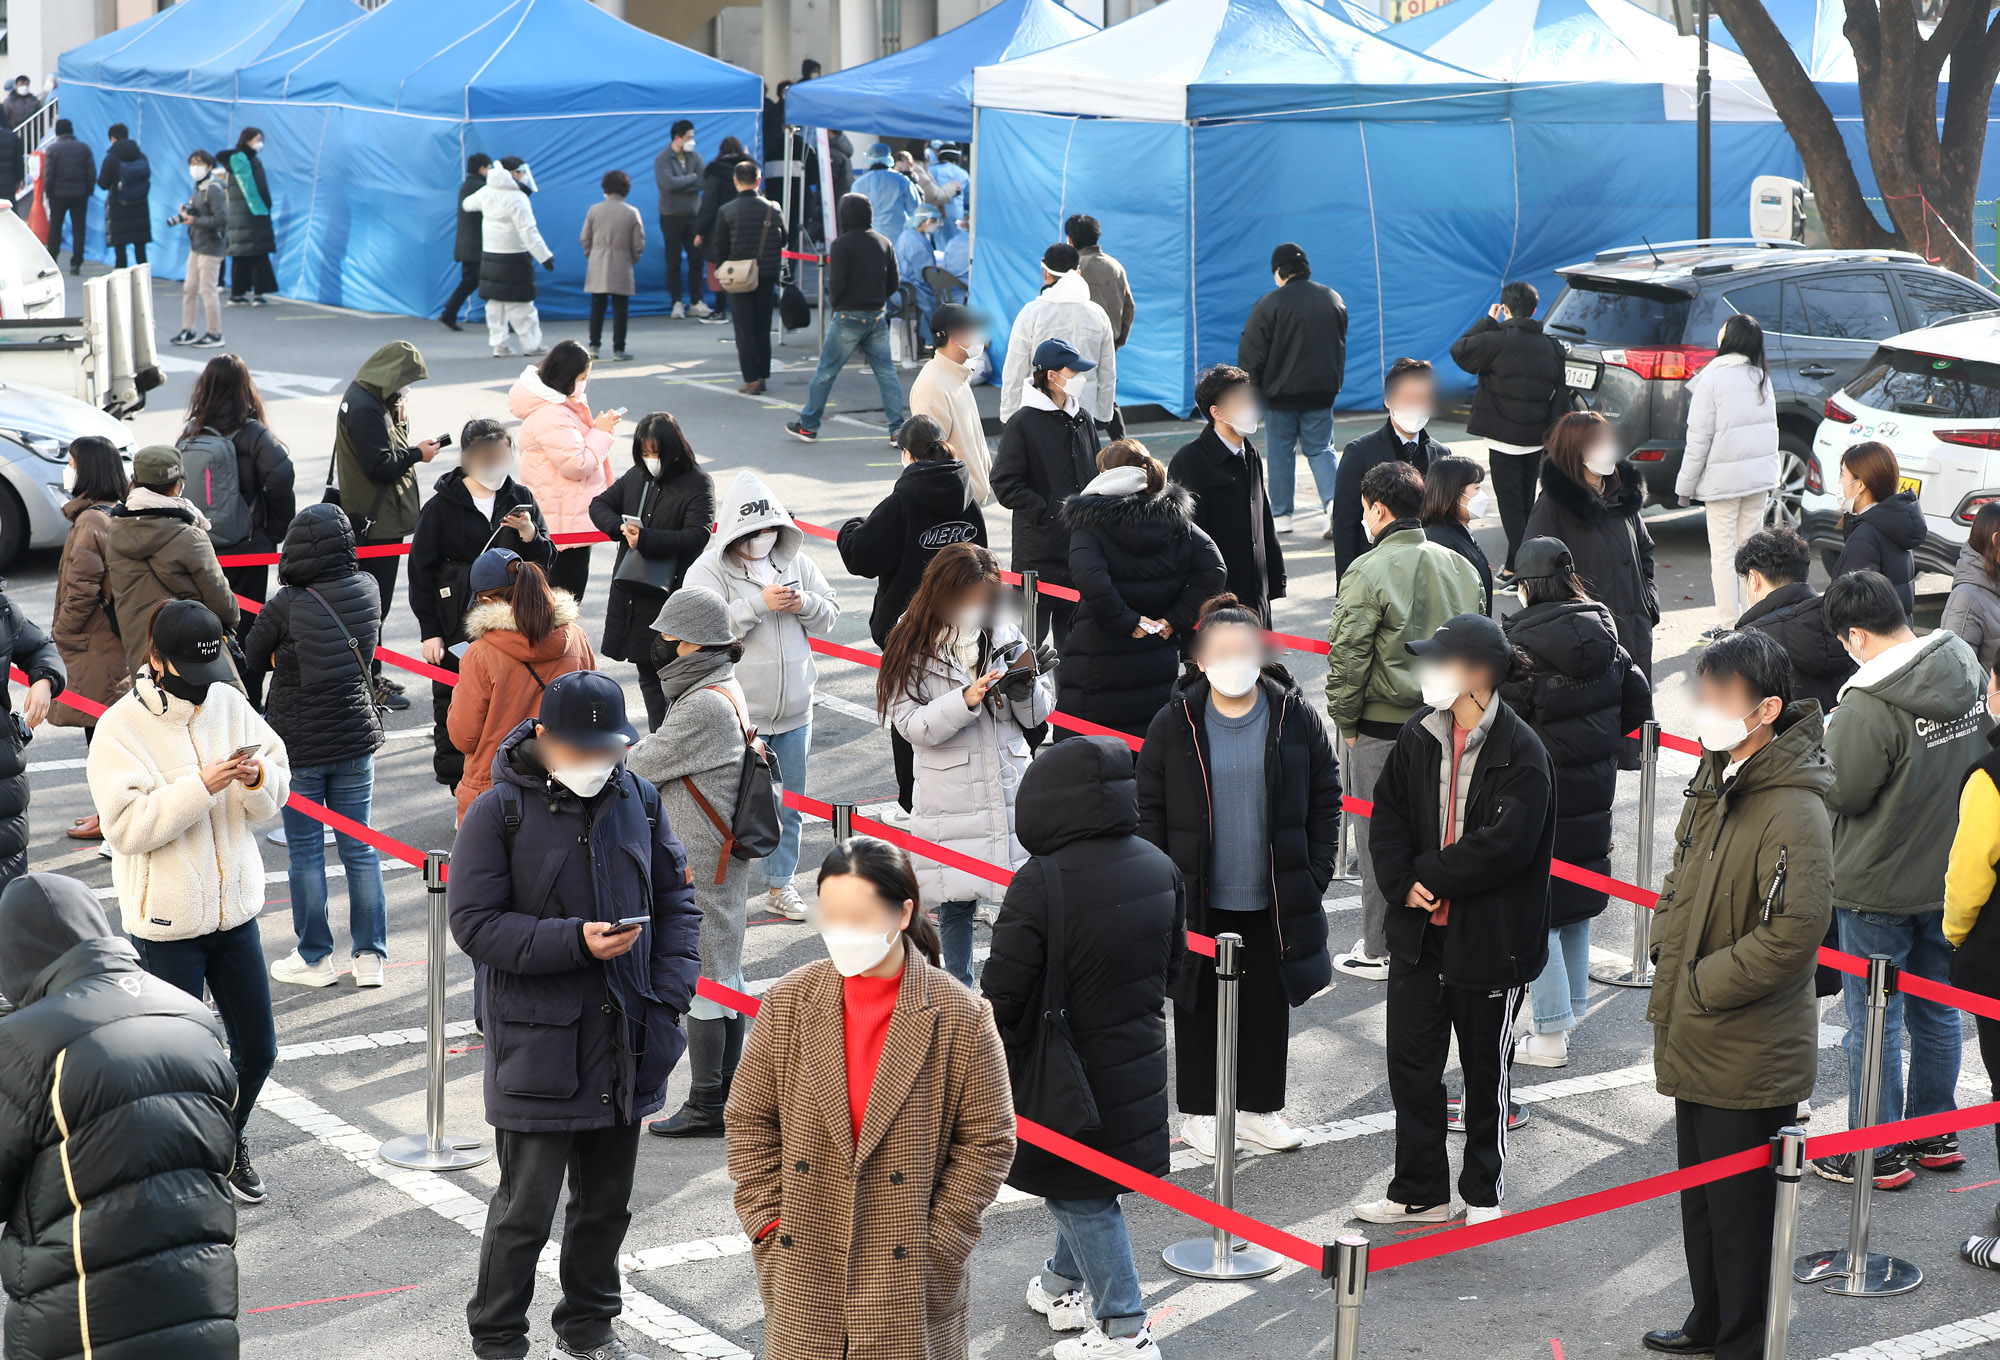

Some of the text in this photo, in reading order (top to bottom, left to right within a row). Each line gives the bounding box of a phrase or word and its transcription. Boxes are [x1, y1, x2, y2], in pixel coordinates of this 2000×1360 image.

[740, 499, 771, 516] ike
[922, 525, 975, 546] MERC
[197, 639, 220, 649] Holiday
[201, 647, 217, 655] Mood
